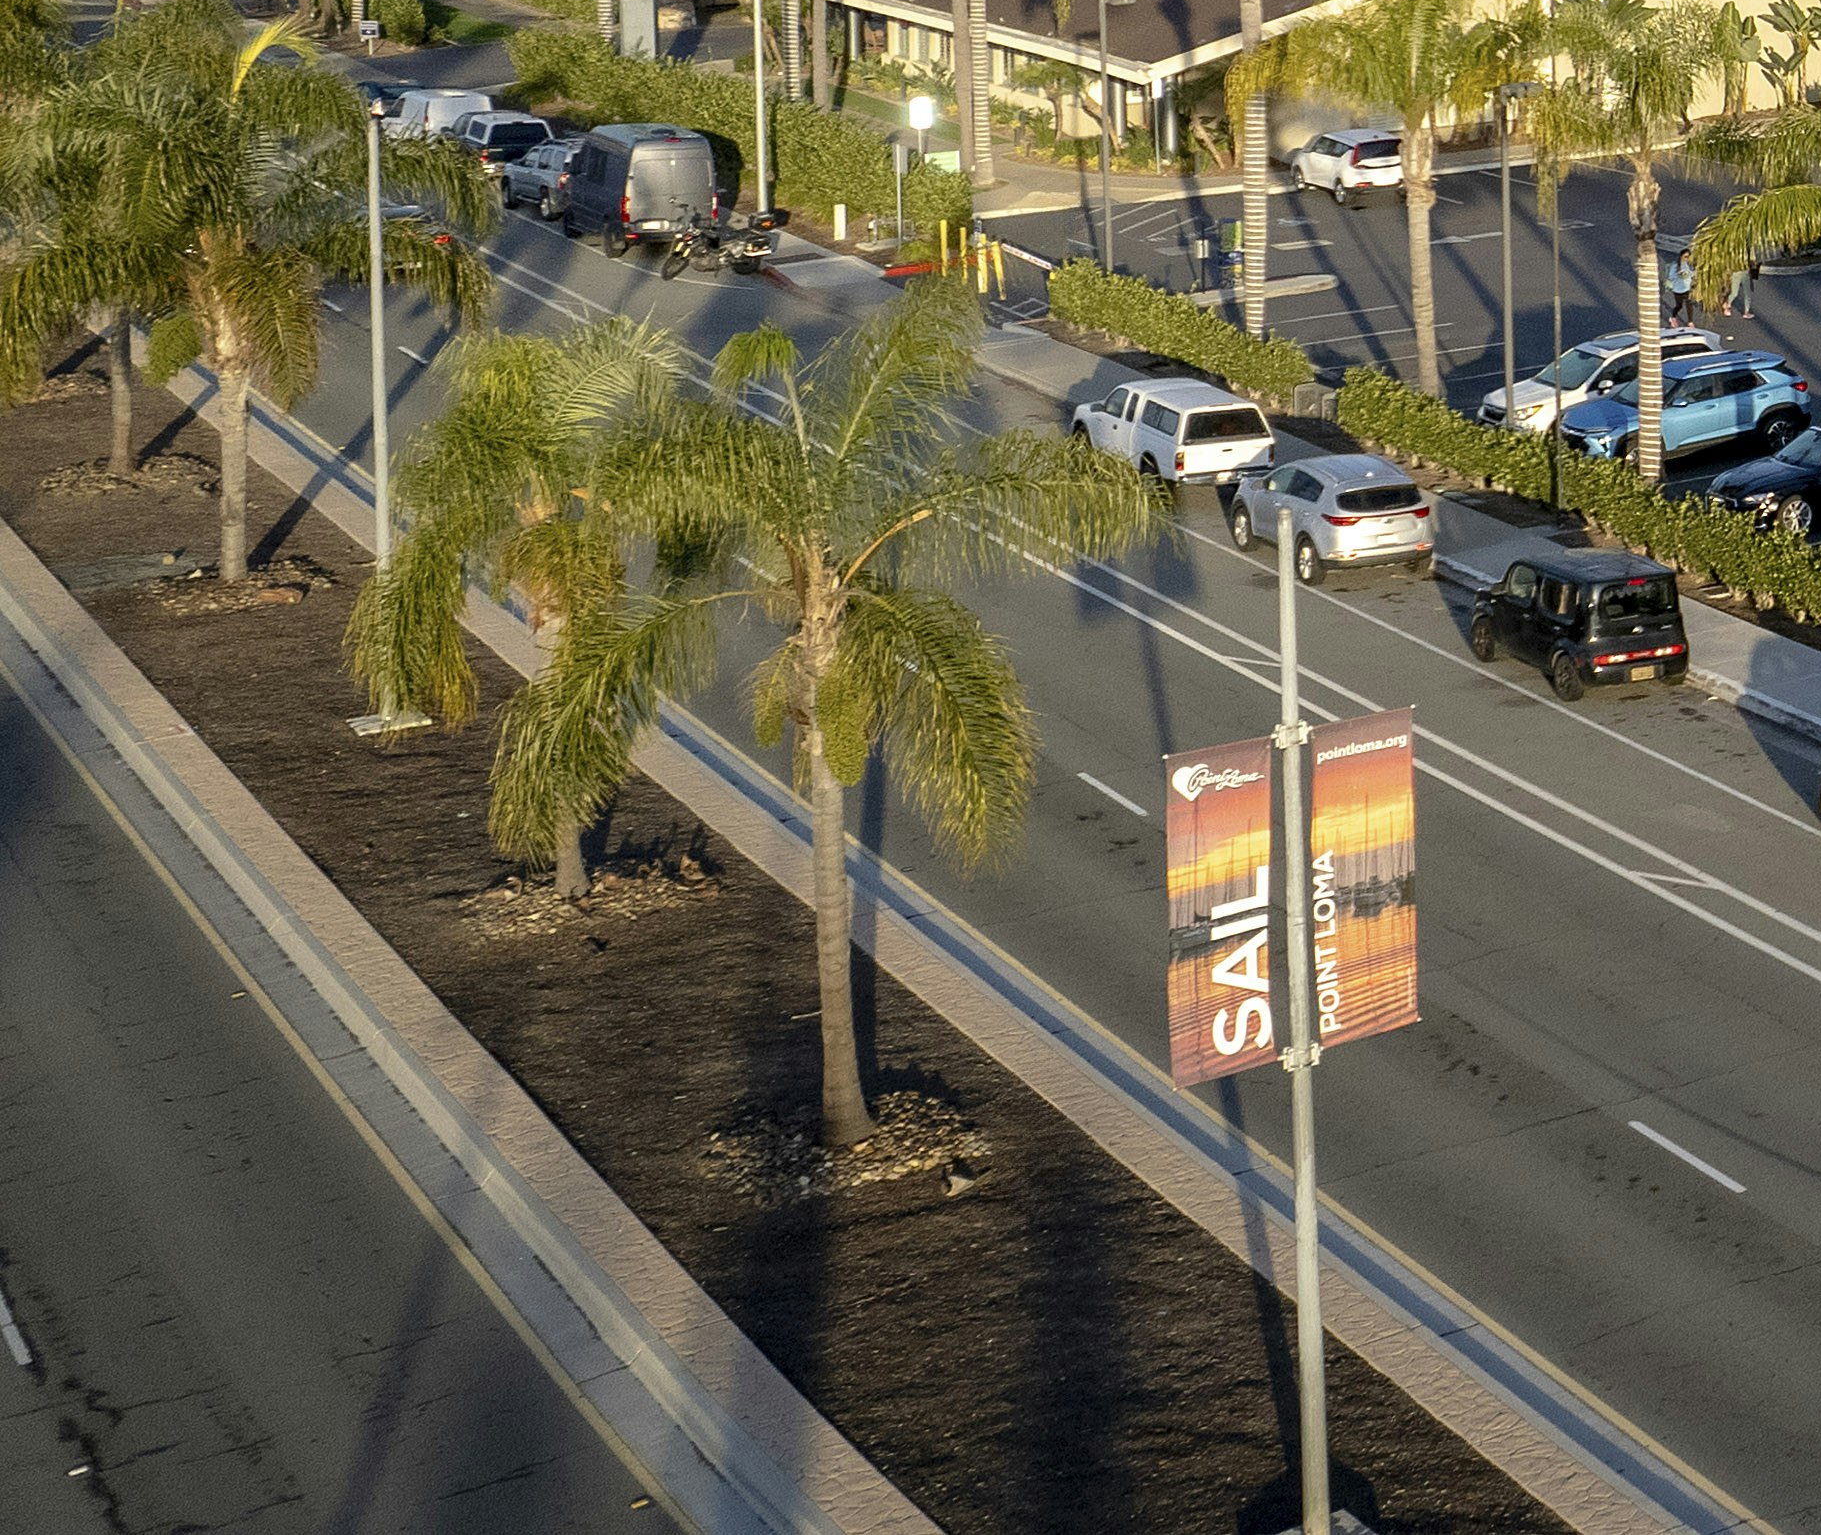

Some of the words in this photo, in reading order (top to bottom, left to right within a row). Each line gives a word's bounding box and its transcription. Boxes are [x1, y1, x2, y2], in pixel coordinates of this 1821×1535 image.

[1316, 732, 1408, 765] pointloma.org
[1312, 849, 1336, 938] LOMA
[1211, 866, 1272, 1056] SAIL
[1314, 946, 1342, 1034] POINT
